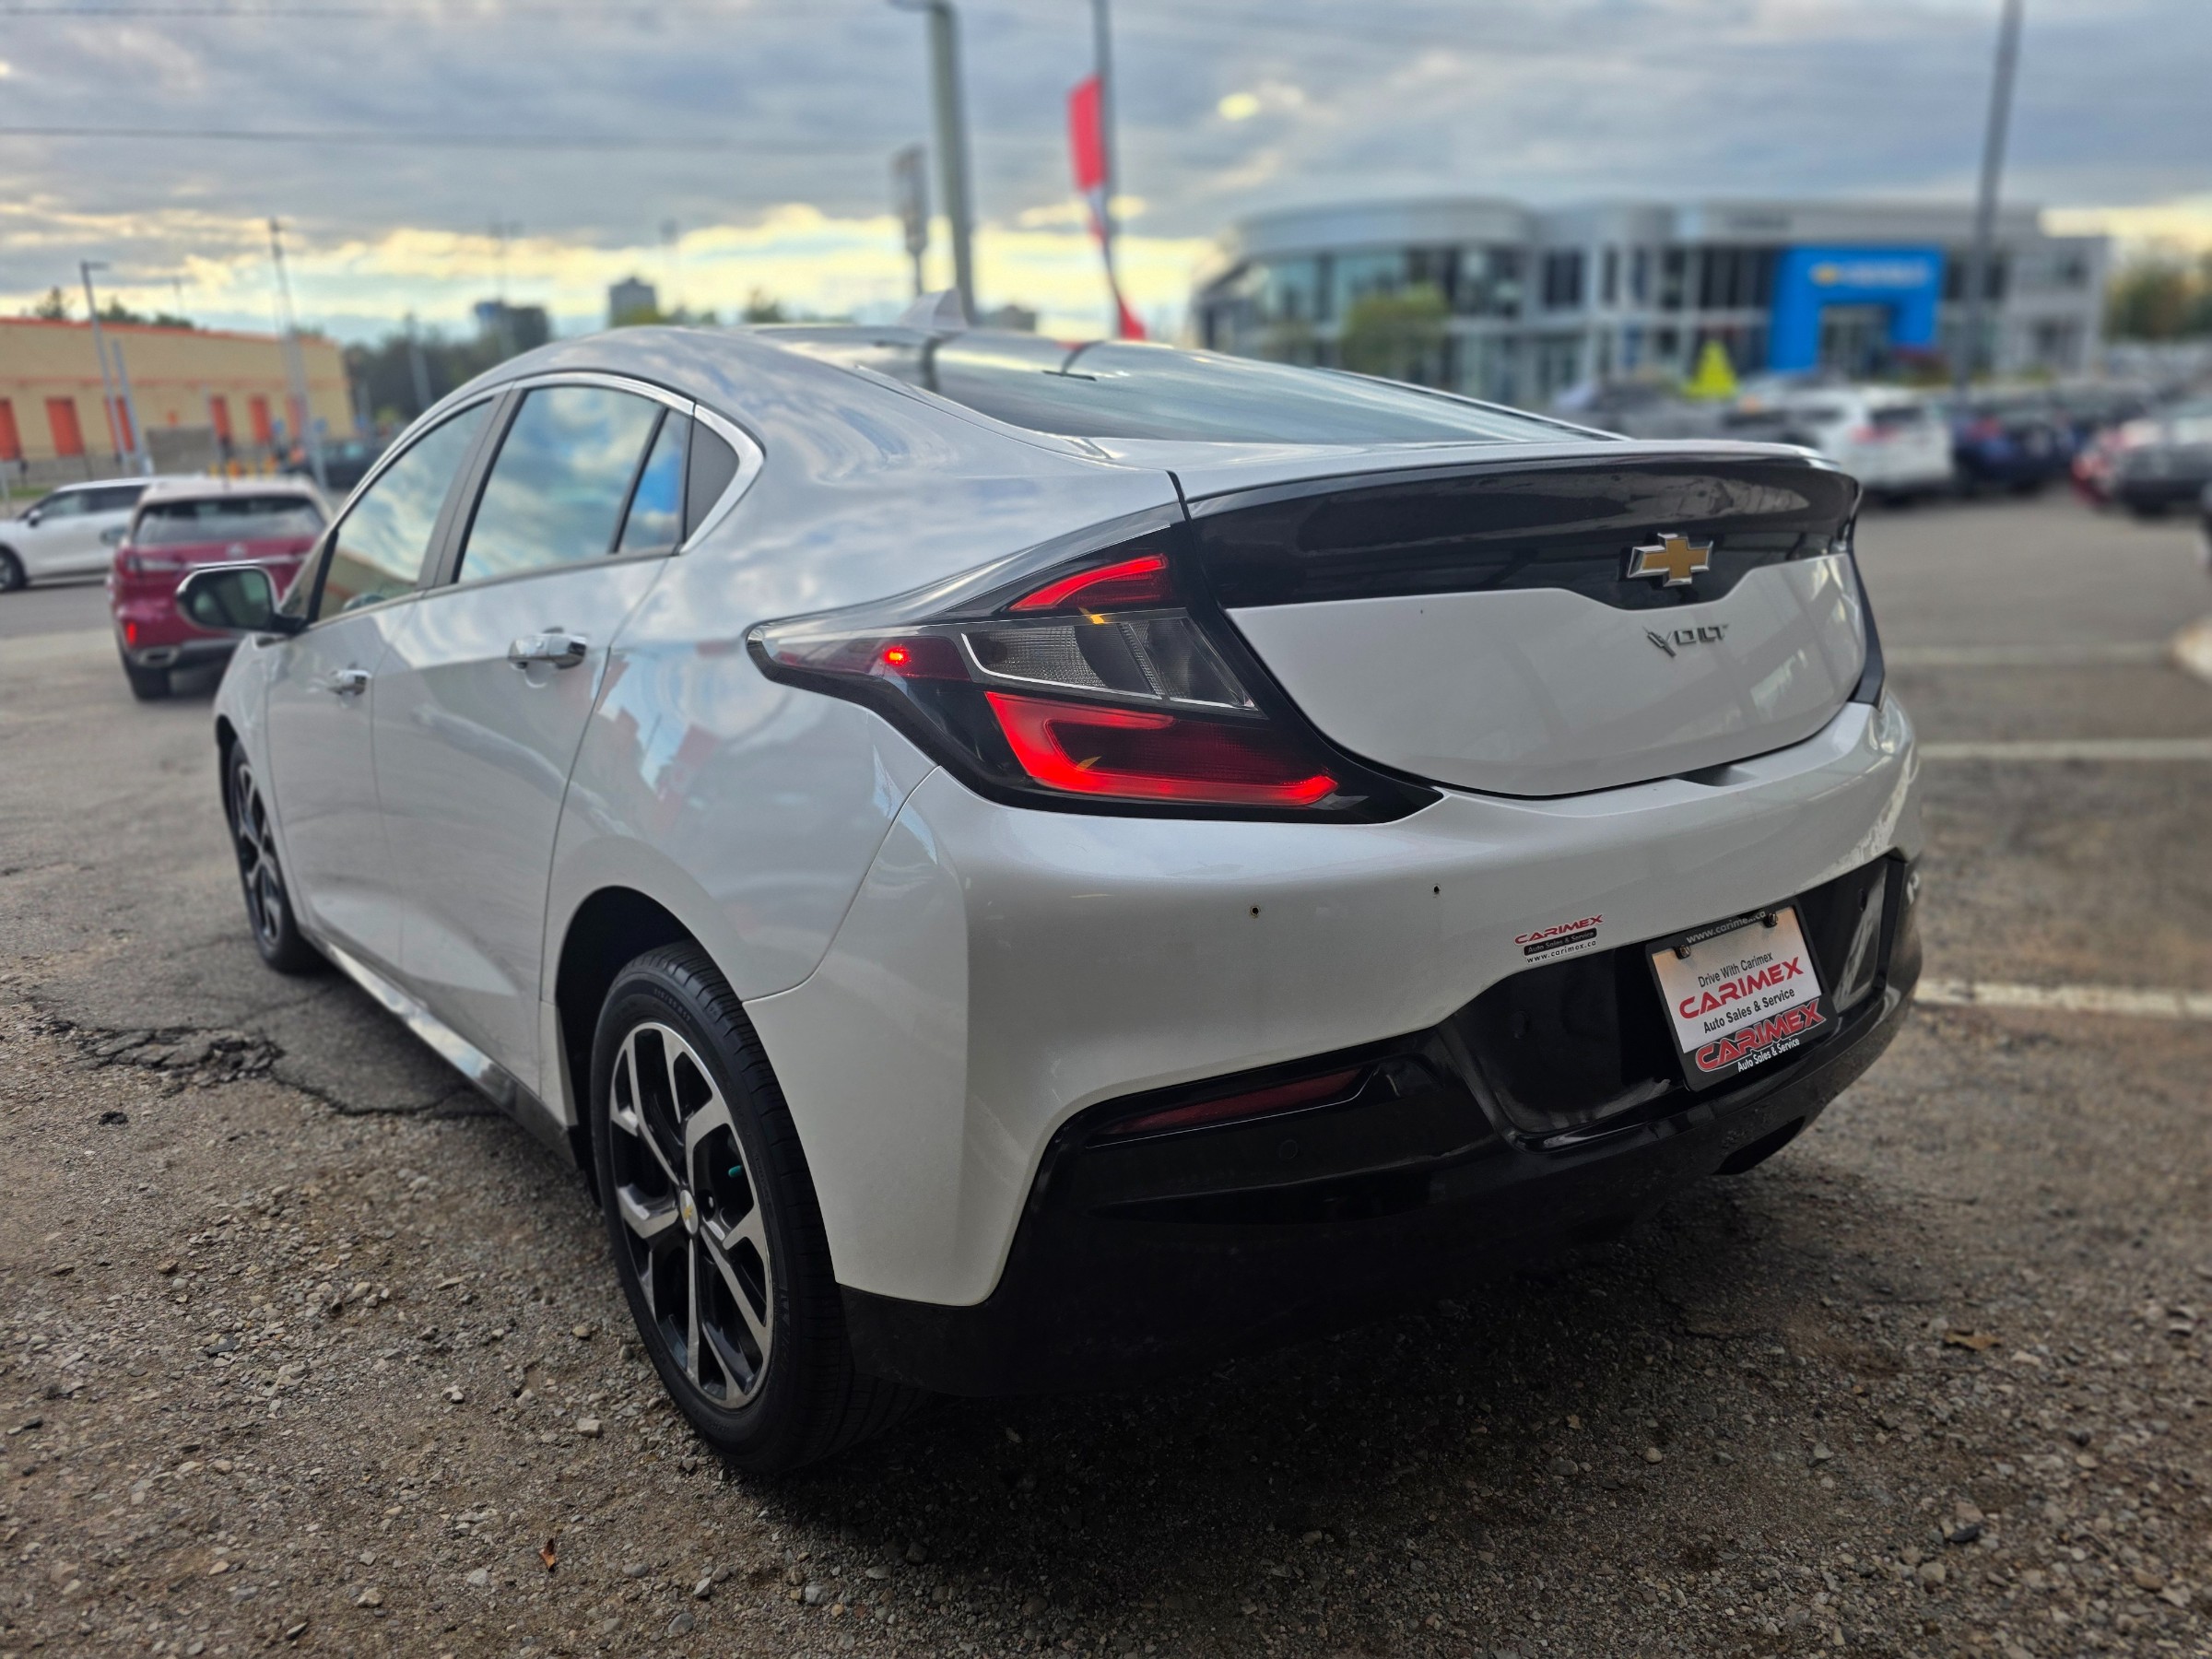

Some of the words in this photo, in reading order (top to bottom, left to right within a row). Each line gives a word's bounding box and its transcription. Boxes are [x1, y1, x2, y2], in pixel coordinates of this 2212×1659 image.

[1642, 624, 1729, 657] VOLT
[1514, 913, 1604, 945] CARIMEX
[1527, 944, 1545, 955] Auto
[1545, 938, 1564, 949] Sales
[1571, 930, 1594, 942] Service
[1526, 940, 1596, 963] www.carimex.ca
[1698, 972, 1721, 988] Drive
[1720, 962, 1740, 979] With
[1740, 951, 1774, 971] Carimex
[1679, 956, 1805, 1019] CARIMEX
[1703, 1017, 1725, 1034] Auto
[1725, 1006, 1752, 1024] Sales
[1753, 1000, 1761, 1012] &
[1762, 988, 1795, 1008] Service
[1696, 998, 1826, 1072] CARIMEX
[1736, 1058, 1754, 1073] Auto
[1753, 1050, 1771, 1065] Sales
[1771, 1046, 1778, 1056] &
[1777, 1037, 1800, 1054] Service
